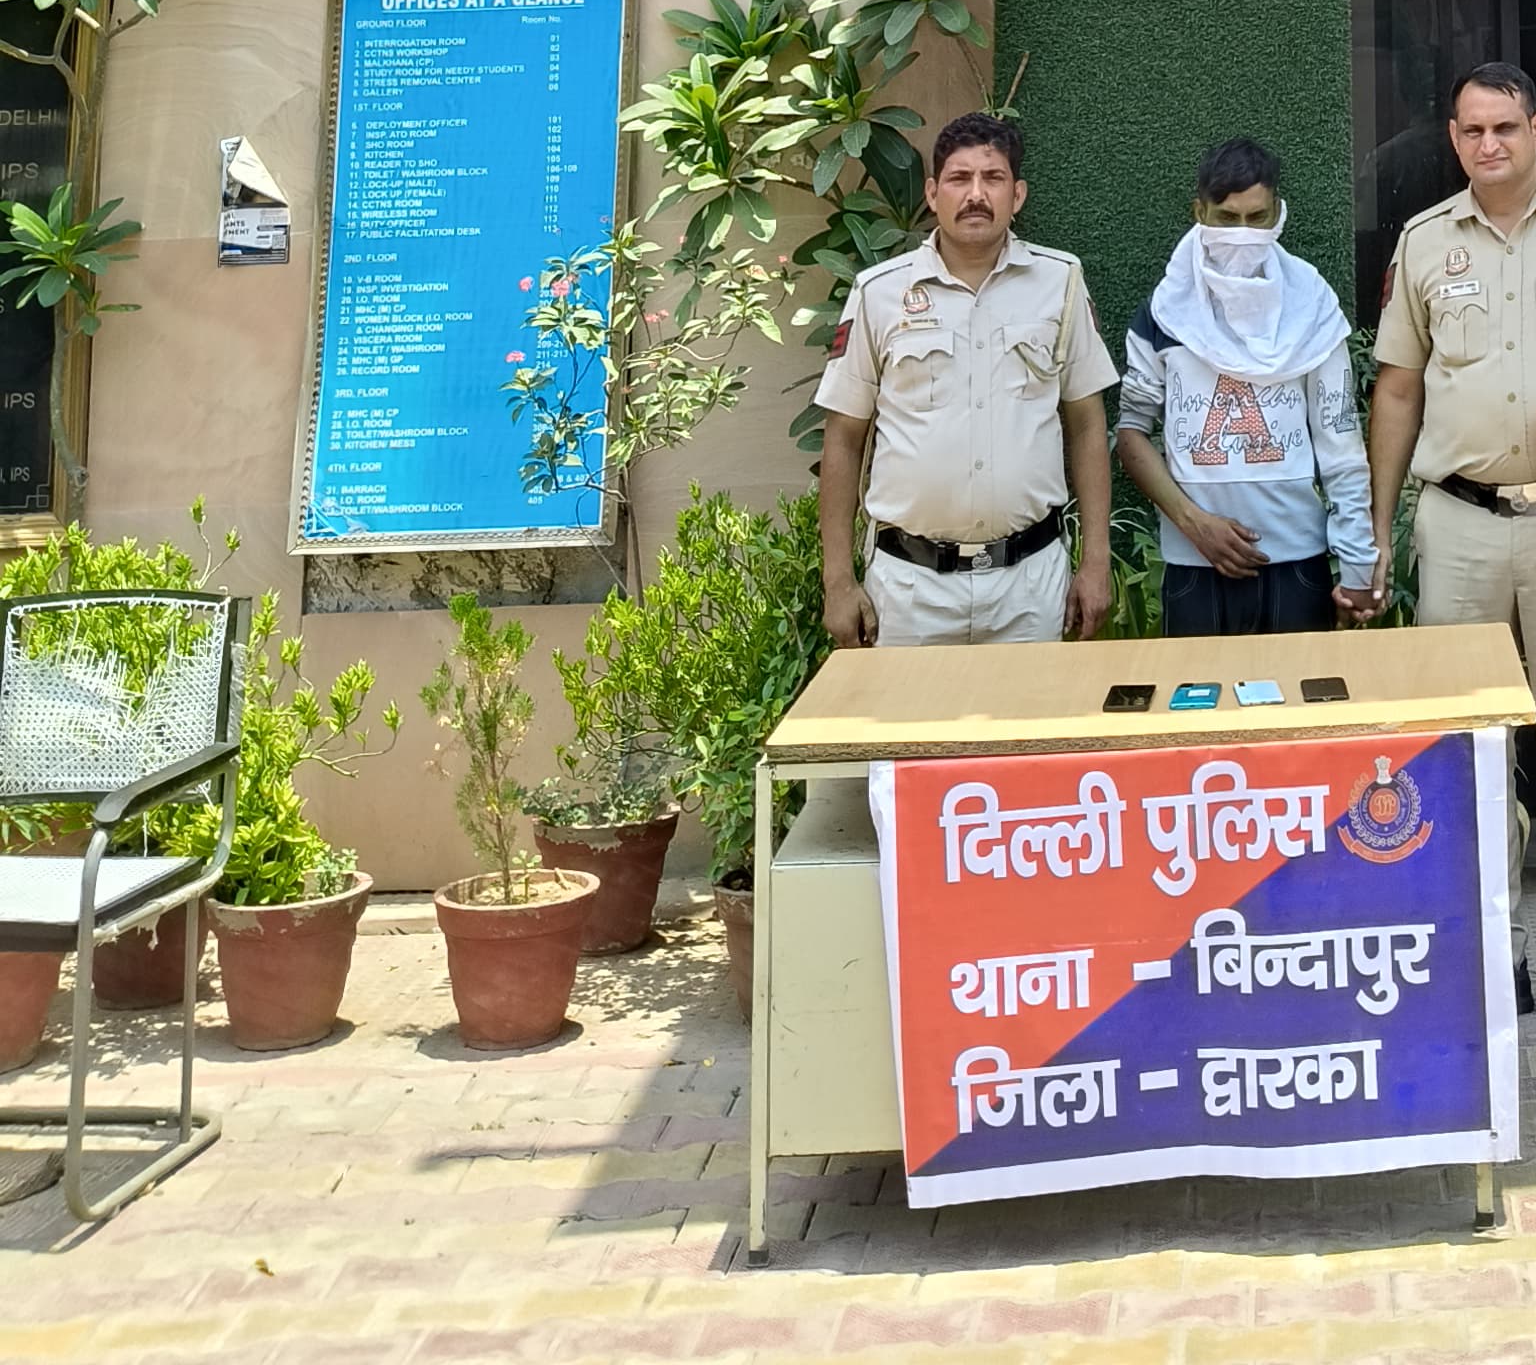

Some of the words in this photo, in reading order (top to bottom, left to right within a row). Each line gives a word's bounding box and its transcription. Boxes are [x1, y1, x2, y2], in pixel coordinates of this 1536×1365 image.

[356, 20, 393, 28] GROUND
[396, 19, 426, 27] FLOOR
[365, 39, 436, 47] INTERROGATION
[364, 59, 413, 67] MALKHANA
[364, 69, 392, 77] STUDY
[363, 79, 398, 87] STRESS
[401, 78, 443, 86] REMOVAL
[446, 76, 481, 85] CENTER
[366, 120, 427, 129] DEPLOYMENT
[429, 119, 467, 127] OFFICER
[365, 141, 384, 149] SHO
[387, 140, 414, 148] ROOM
[419, 159, 437, 167] SHO
[2, 162, 39, 179] IPS
[401, 169, 454, 177] WASHROOM
[406, 179, 436, 187] (MALE)
[405, 189, 446, 197] (FEMALE)
[410, 209, 437, 217] ROOM
[361, 221, 384, 229] DUTY
[360, 230, 392, 238] PUBLIC
[395, 229, 454, 237] FACILITATION
[367, 253, 397, 261] FLOOR
[381, 284, 448, 293] INVESTIGATION
[373, 295, 400, 303] ROOM
[392, 315, 423, 323] BLOCK
[366, 325, 413, 333] CHANGING
[354, 336, 392, 344] VISCERA
[395, 335, 422, 343] ROOM
[354, 346, 384, 354] TOILET
[391, 344, 445, 353] WASHROOM
[392, 365, 419, 373] ROOM
[358, 388, 388, 397] FLOOR
[1170, 373, 1301, 413] American
[4, 393, 35, 409] IPS
[363, 419, 392, 427] ROOM
[437, 427, 468, 435] BLOCK
[1175, 417, 1303, 455] Exclusive
[389, 439, 415, 448] MESS
[350, 463, 382, 471] FLOOR
[11, 467, 30, 482] IPS
[342, 485, 386, 494] BARRACK
[357, 495, 386, 503] ROOM
[432, 503, 463, 511] BLOCK
[940, 771, 1126, 883] दिल्ली
[1144, 761, 1329, 896] पुलिस
[951, 949, 1094, 1016] थाना
[1192, 908, 1435, 1015] बिन्दापुर
[951, 1046, 1120, 1133] जिला
[1197, 1041, 1382, 1116] द्वारका
